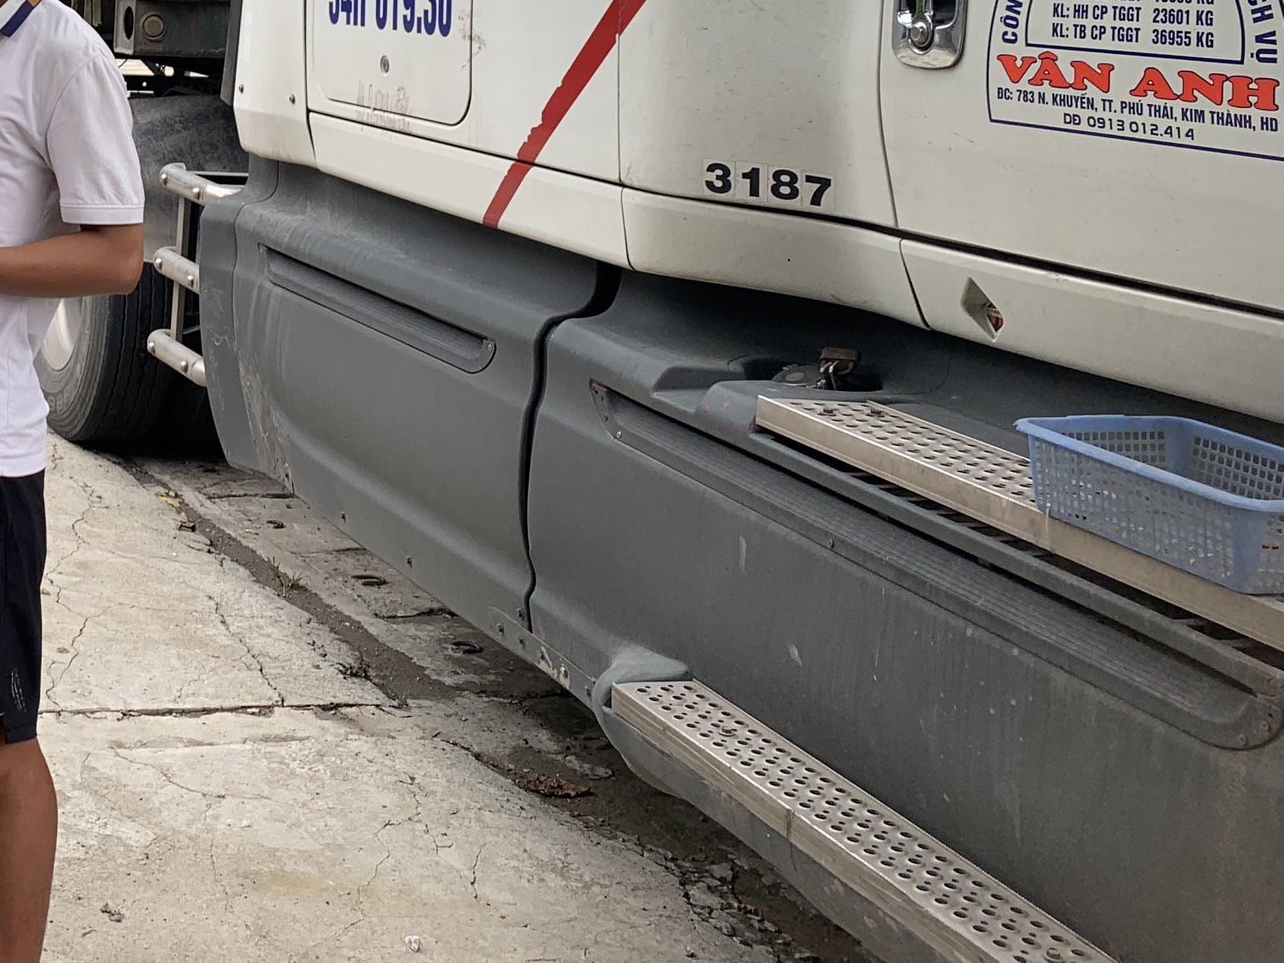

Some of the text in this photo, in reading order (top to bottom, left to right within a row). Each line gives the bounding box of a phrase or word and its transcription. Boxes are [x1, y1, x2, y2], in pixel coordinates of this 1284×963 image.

[1052, 3, 1214, 27] KL: HH CP TGGT 23601 KG
[1051, 23, 1214, 49] KL: TB CP TGGT 36955 KG
[1250, 30, 1277, 64] VỤ
[996, 51, 1281, 112] VÂN ANH
[1016, 89, 1035, 103] 783
[1038, 91, 1049, 105] N.
[1101, 98, 1117, 113] TT.
[1120, 99, 1143, 116] PHÚ
[1147, 102, 1178, 123] THÁI,
[1181, 107, 1205, 124] KIM
[1209, 109, 1256, 132] THÀNH,
[1260, 116, 1278, 132] HD
[704, 163, 832, 207] 3187
